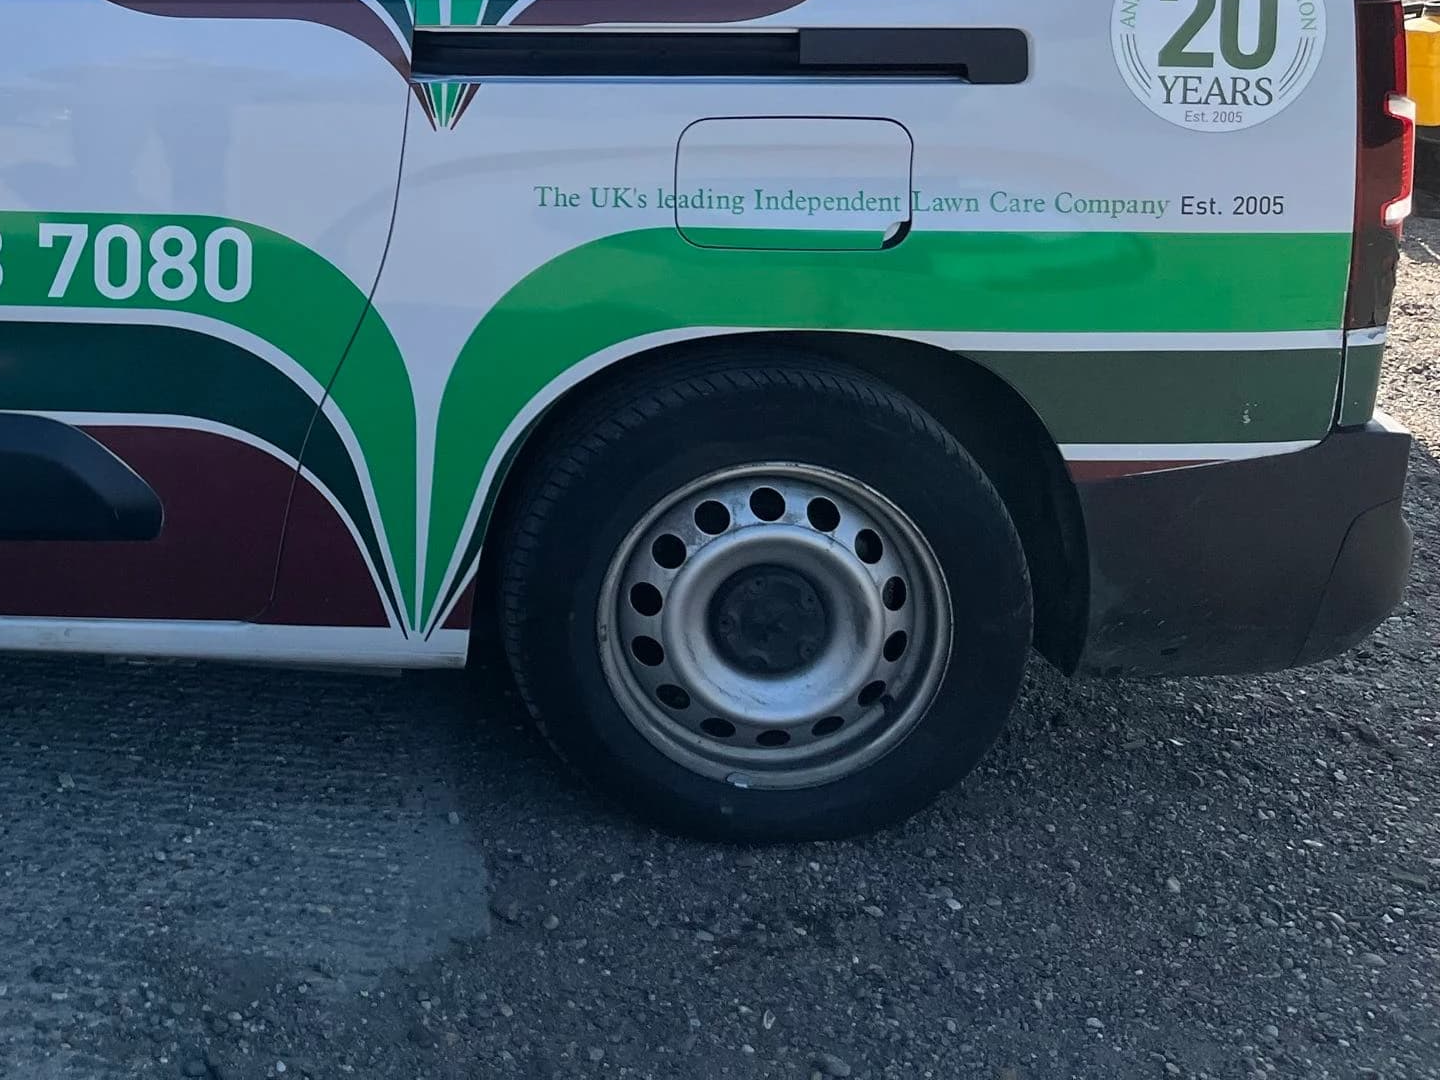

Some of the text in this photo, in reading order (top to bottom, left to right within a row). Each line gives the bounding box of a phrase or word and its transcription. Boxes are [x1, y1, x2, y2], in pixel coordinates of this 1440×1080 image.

[1158, 75, 1273, 105] YEARS
[1185, 111, 1243, 123] Est. 2005
[535, 186, 1284, 219] The UK's leading Independent Lawn Care Company Est. 2005
[38, 223, 253, 303] 7080
